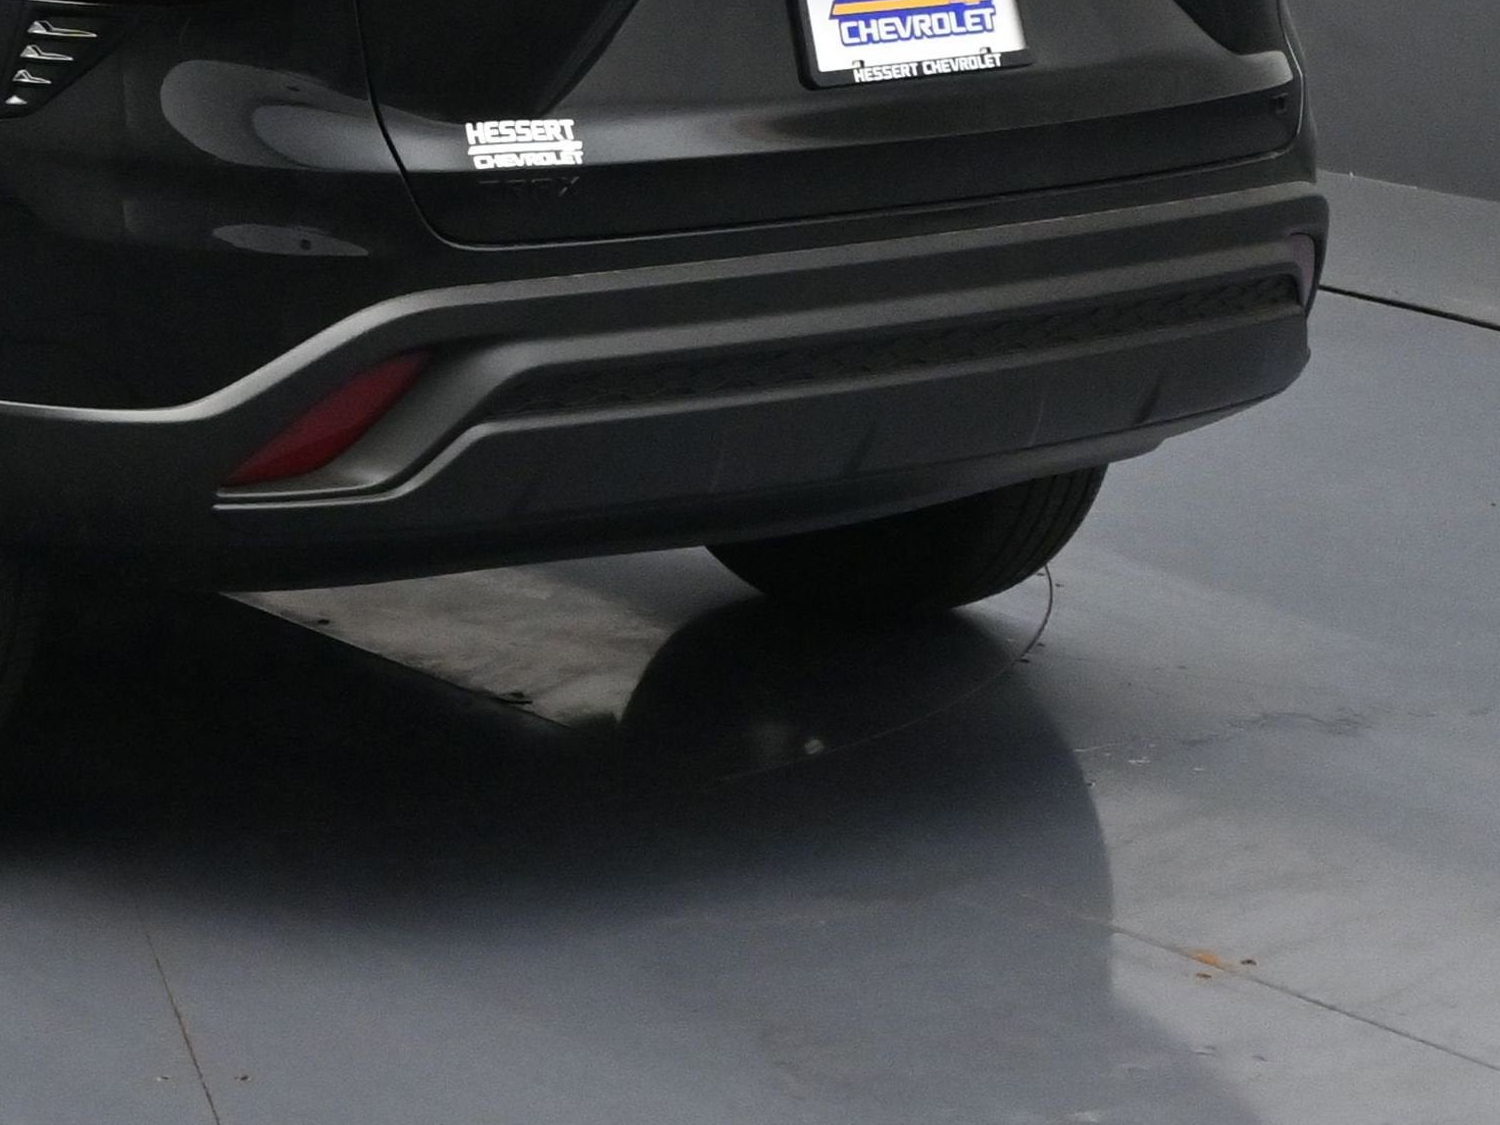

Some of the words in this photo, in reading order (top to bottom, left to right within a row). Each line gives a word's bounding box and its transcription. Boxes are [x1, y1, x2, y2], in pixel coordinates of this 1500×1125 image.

[839, 6, 997, 46] CHEVROLET
[853, 62, 918, 83] HESSERT
[922, 53, 1002, 76] CHEVROLET
[465, 119, 575, 144] HESSERT
[473, 151, 584, 169] CHEVROLET
